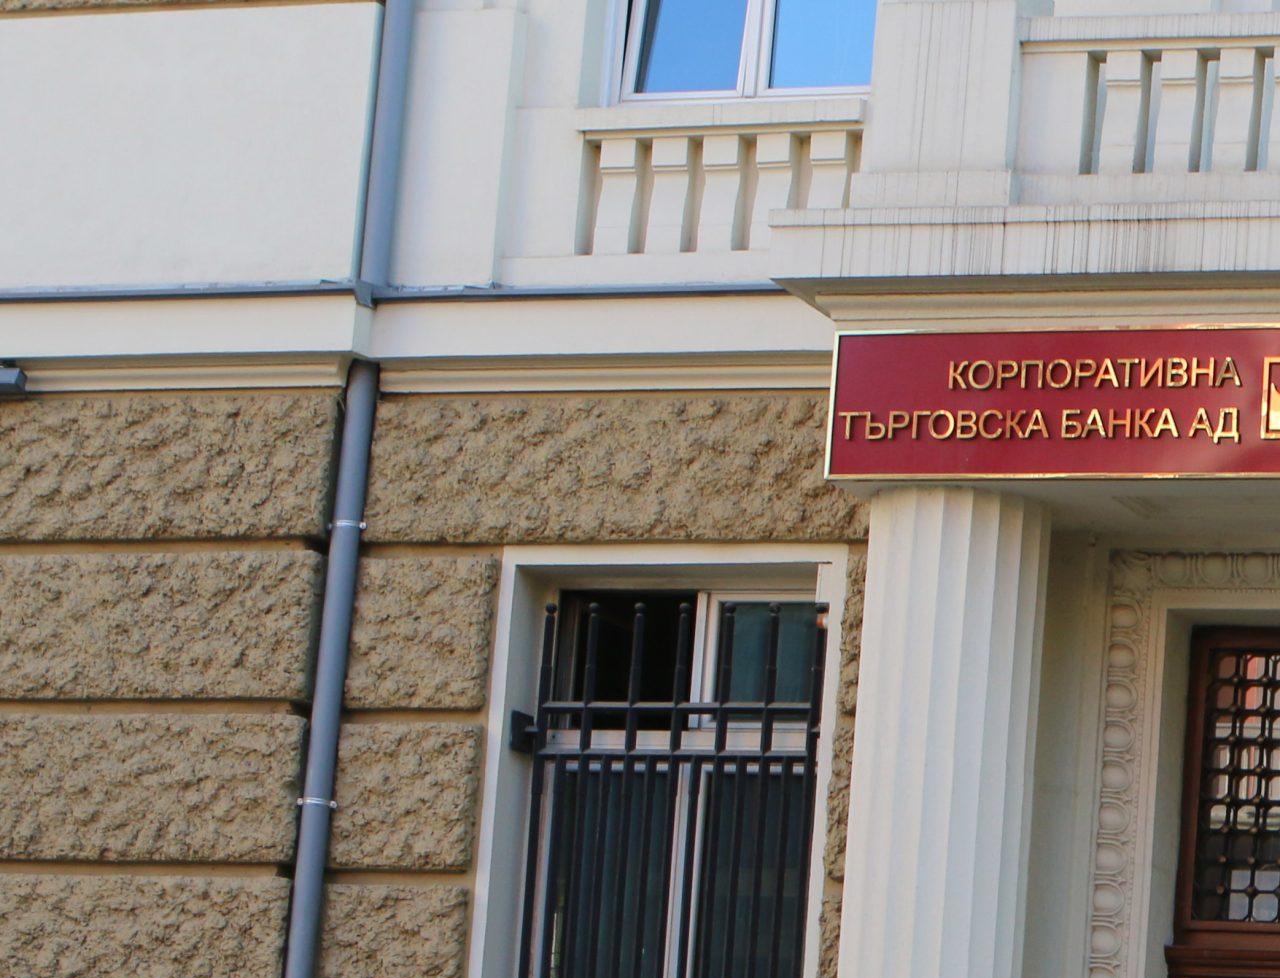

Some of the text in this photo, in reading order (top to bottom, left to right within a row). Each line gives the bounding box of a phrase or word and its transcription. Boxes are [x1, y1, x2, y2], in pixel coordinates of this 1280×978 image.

[948, 357, 1242, 390] КОРПОРАТИВНА
[838, 406, 1240, 444] ТЪРГОВСКА БАНКА АД
